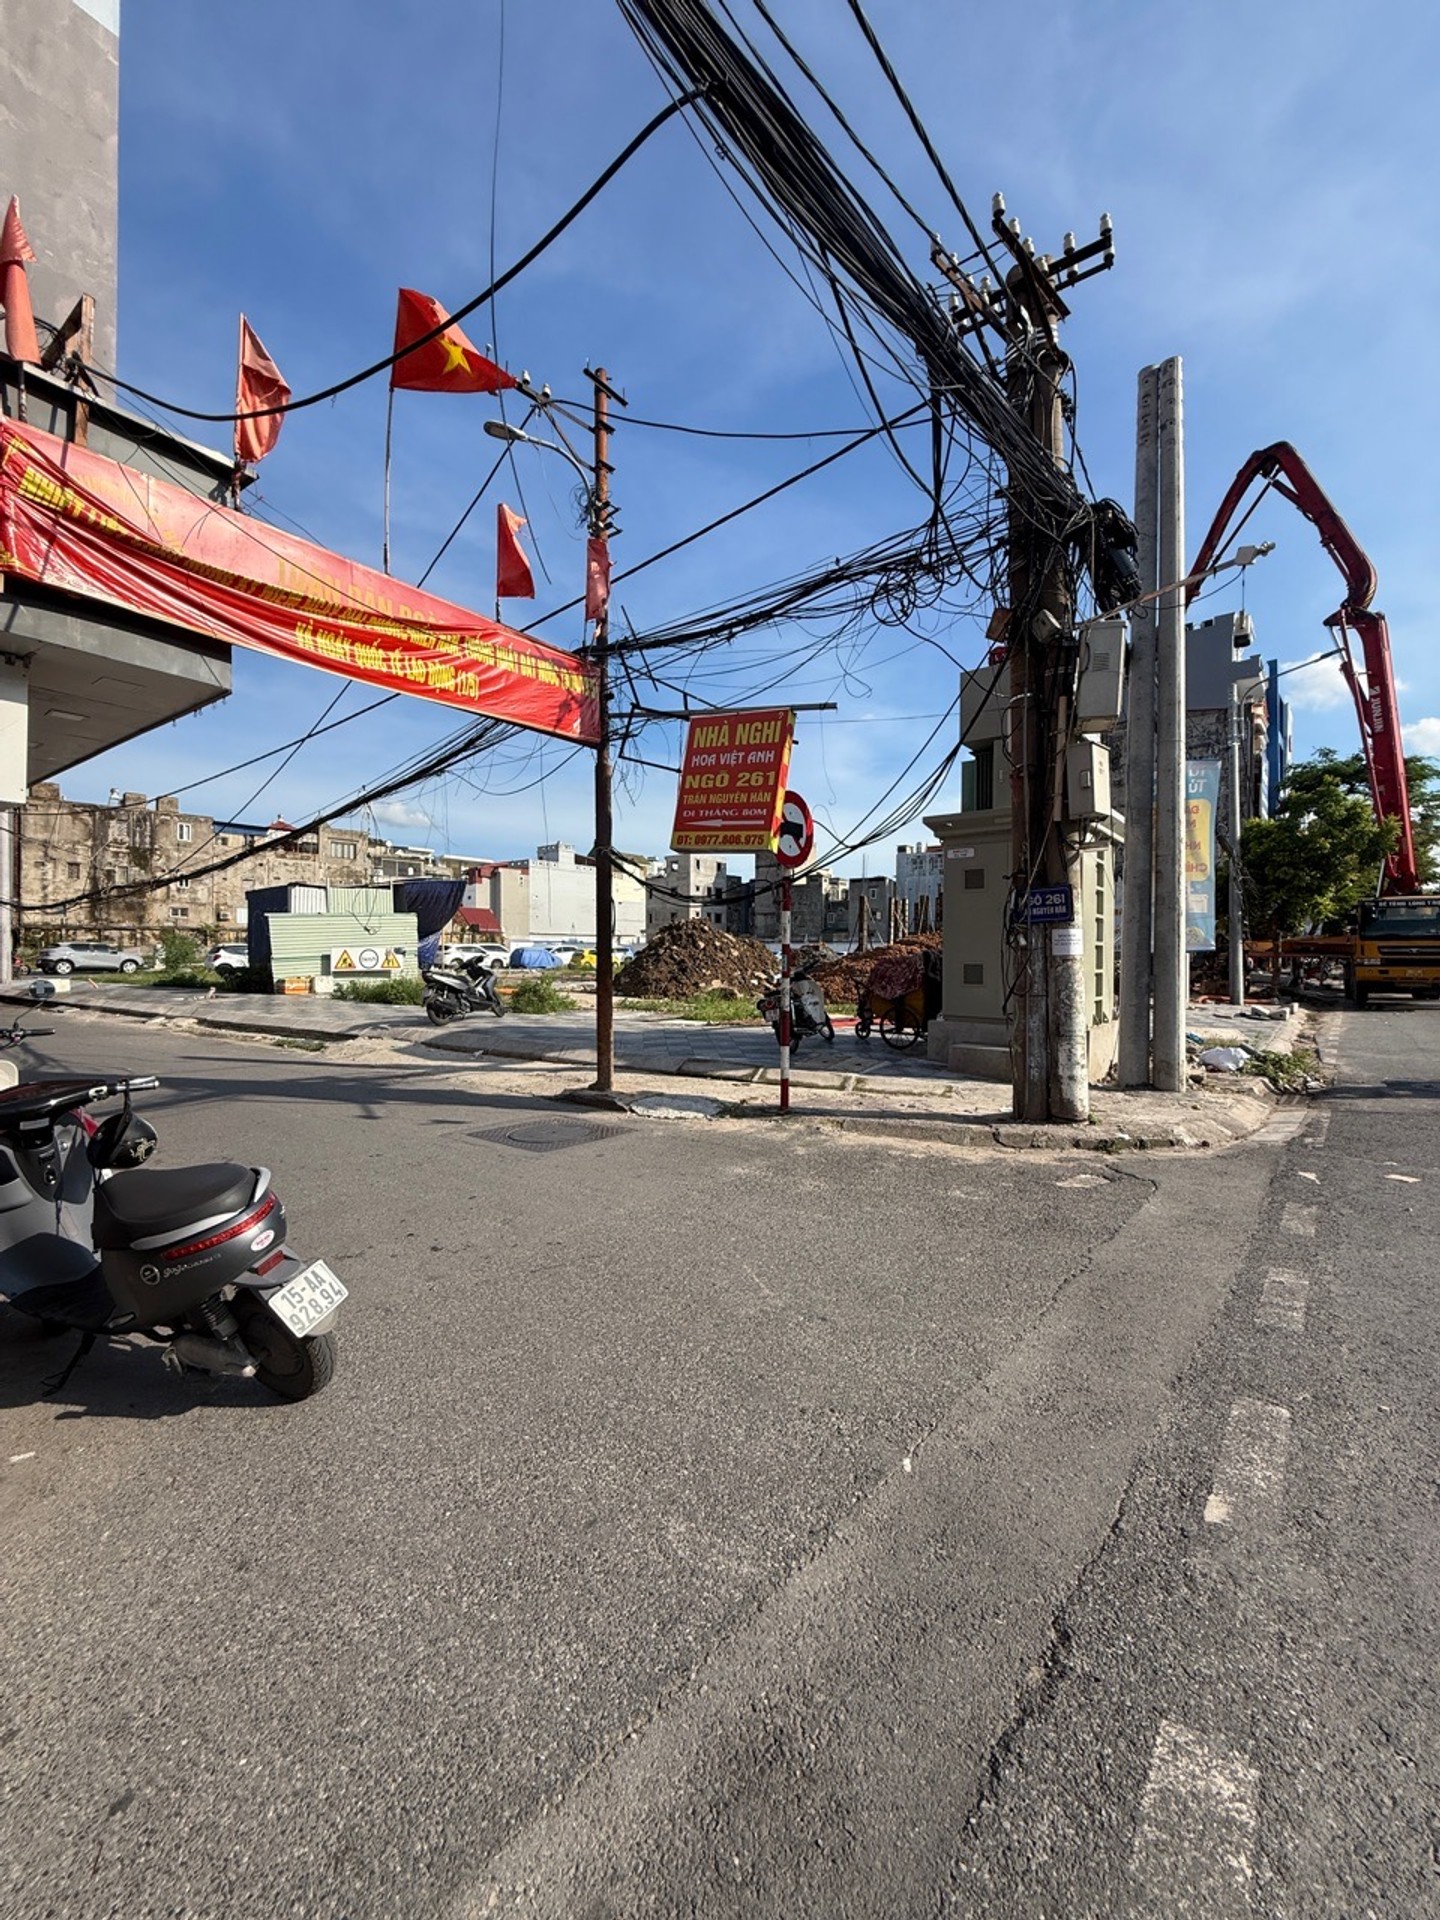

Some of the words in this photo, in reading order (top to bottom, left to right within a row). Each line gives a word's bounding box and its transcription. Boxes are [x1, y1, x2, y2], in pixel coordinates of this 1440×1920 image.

[1371, 698, 1384, 733] JUNJIN
[692, 721, 730, 748] NHÀ
[691, 753, 717, 768] HOA
[720, 750, 744, 767] VIỆT
[747, 750, 776, 764] ANH
[735, 771, 776, 787] 261
[1045, 893, 1065, 905] 261
[281, 1270, 327, 1309] 15-AA
[289, 1282, 343, 1333] 928.94
